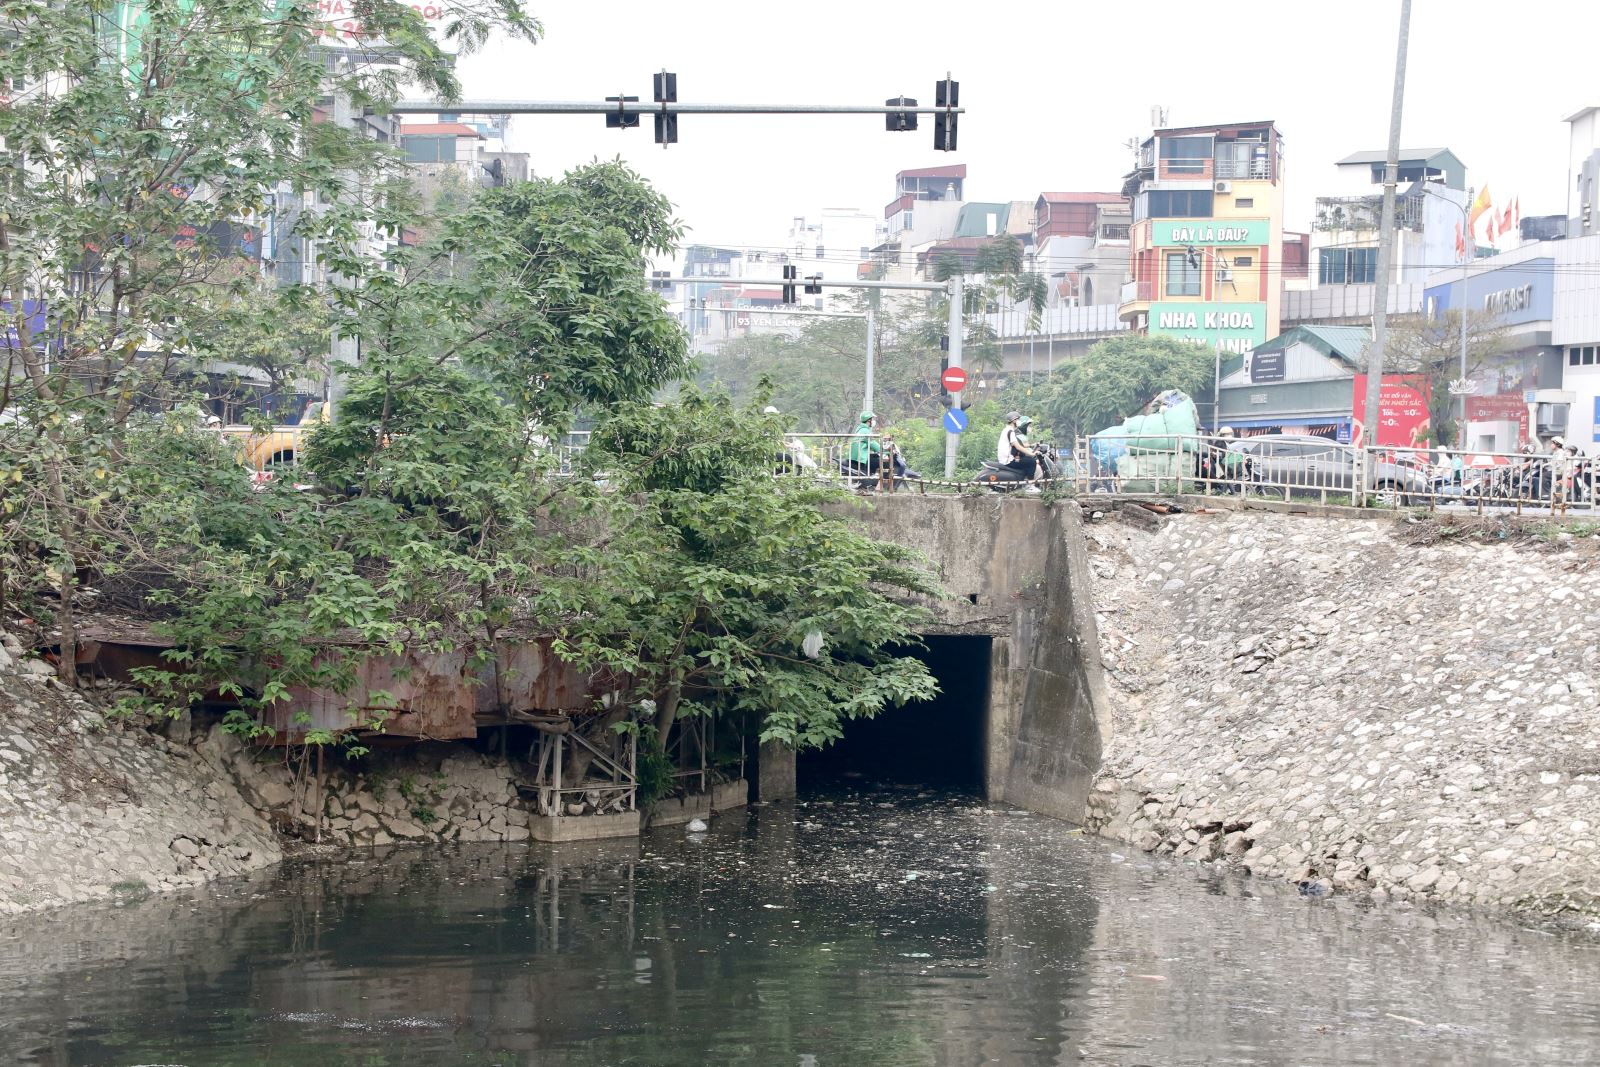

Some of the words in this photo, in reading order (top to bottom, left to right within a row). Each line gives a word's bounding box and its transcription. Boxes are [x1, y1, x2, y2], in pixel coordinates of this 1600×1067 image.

[1172, 226, 1196, 242] ĐÂY
[1198, 225, 1214, 242] LÀ
[1217, 226, 1249, 242] ĐÂU?
[737, 318, 750, 326] 93
[1159, 311, 1198, 329] NHA
[1204, 311, 1254, 329] KHOA
